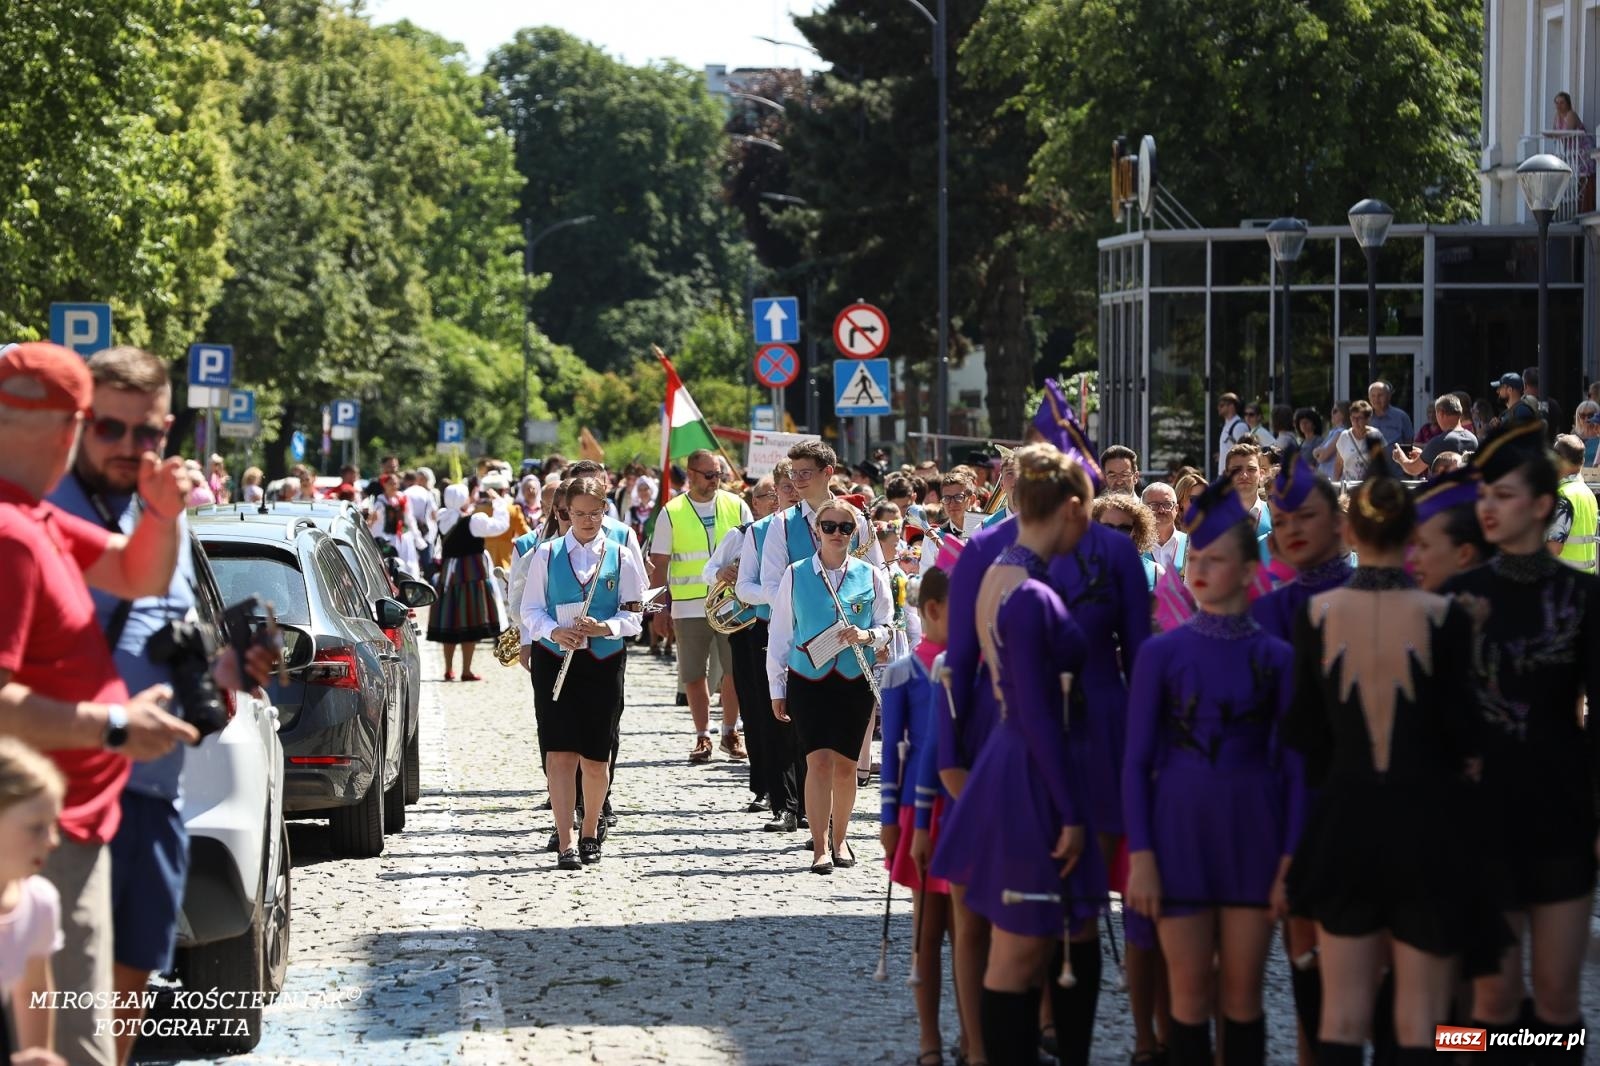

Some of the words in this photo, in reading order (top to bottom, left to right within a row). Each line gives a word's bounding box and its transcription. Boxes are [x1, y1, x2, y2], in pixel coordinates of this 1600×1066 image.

[64, 310, 98, 350] P
[199, 349, 224, 382] P
[228, 393, 248, 419] P
[337, 402, 355, 424] P
[444, 421, 459, 440] P
